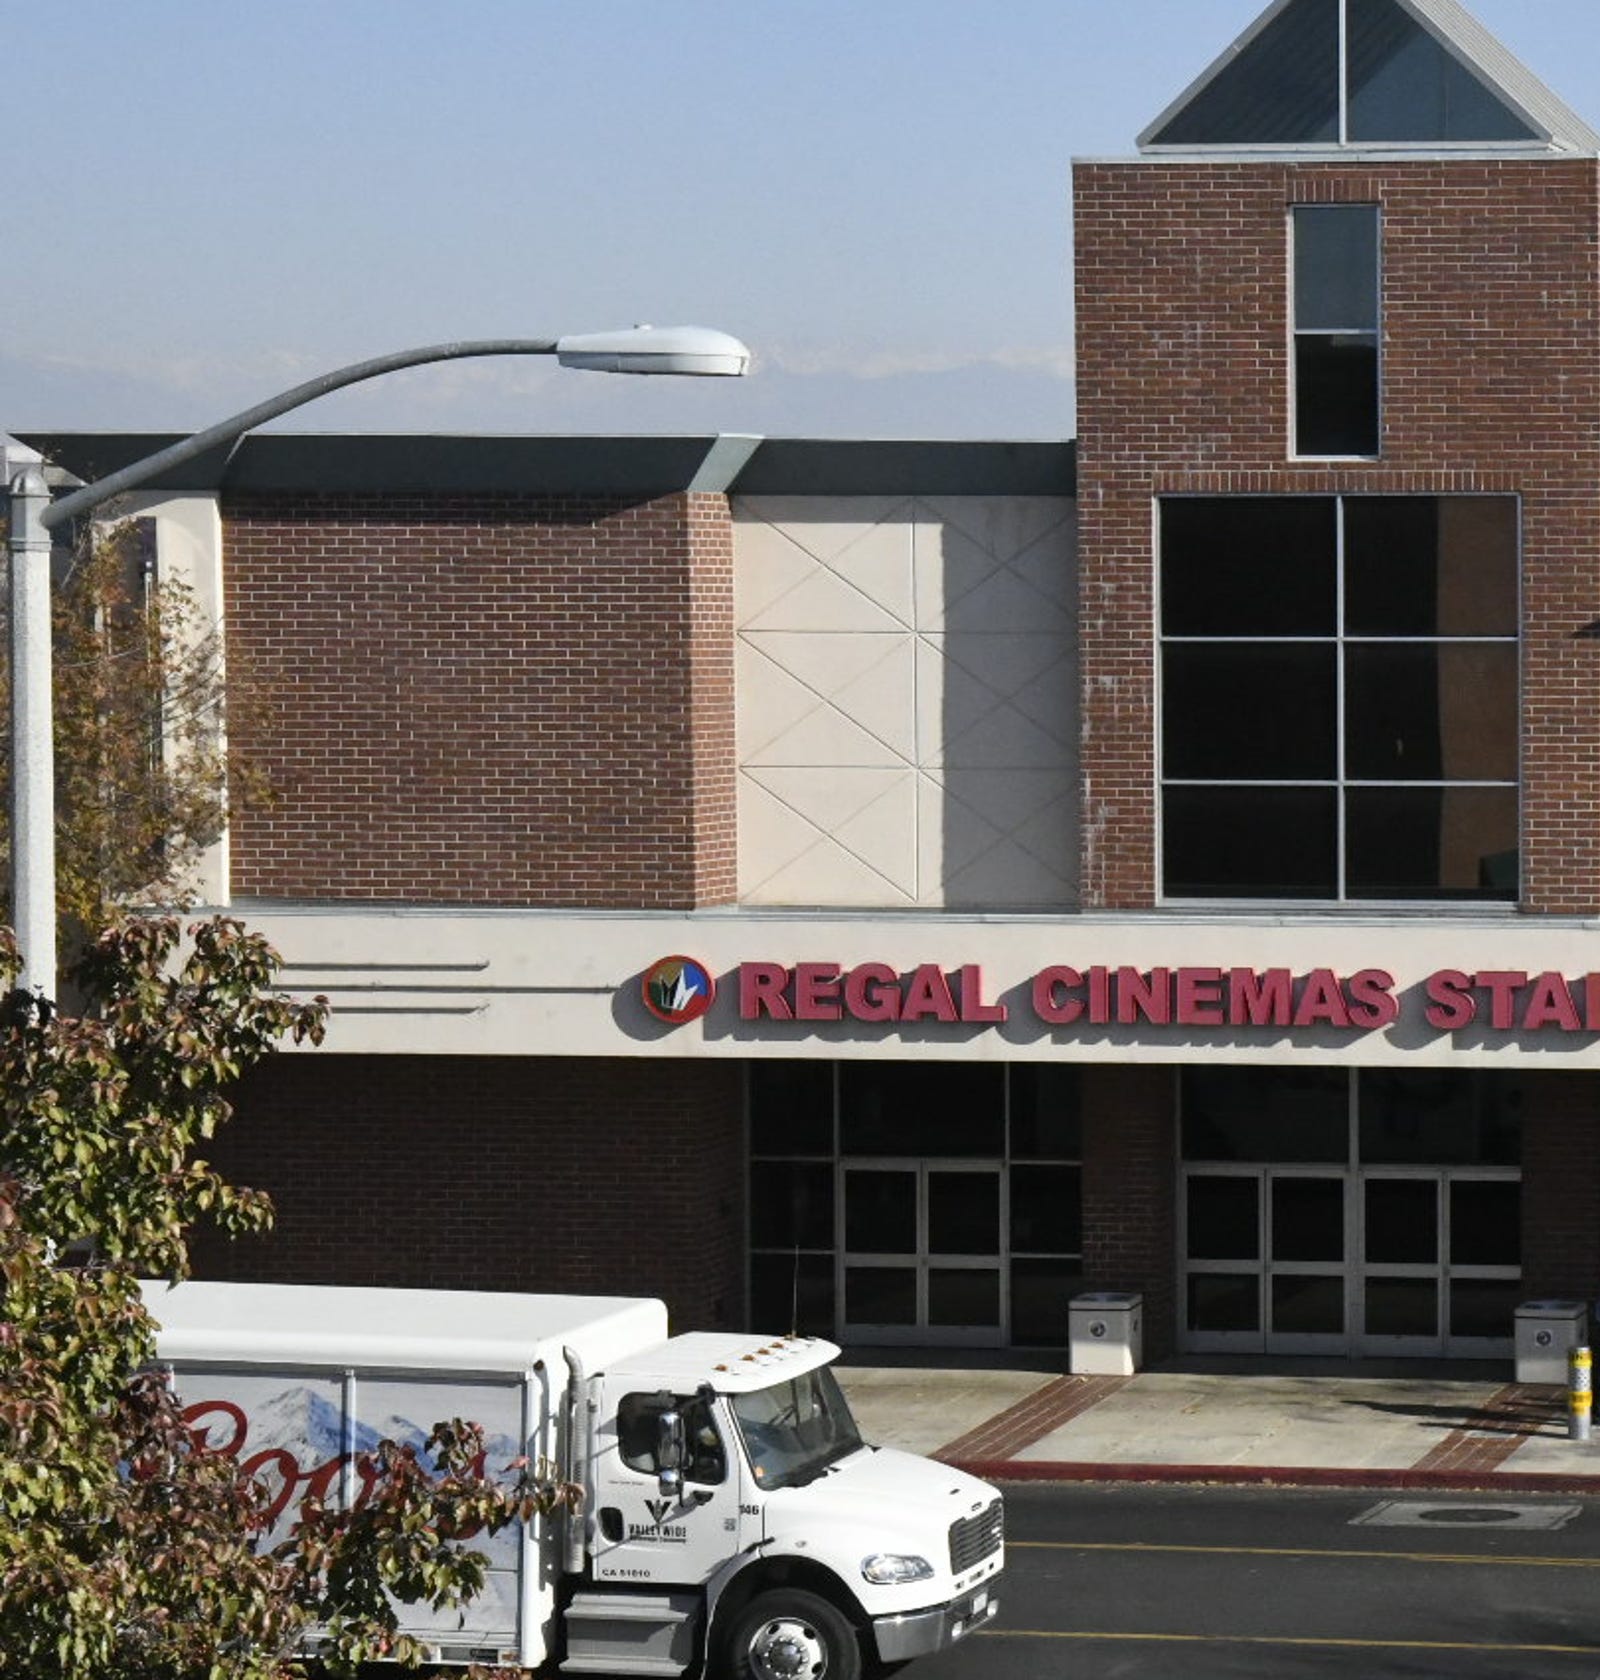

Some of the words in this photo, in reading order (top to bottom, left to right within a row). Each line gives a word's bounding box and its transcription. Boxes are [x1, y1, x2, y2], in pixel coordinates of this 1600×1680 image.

[738, 961, 1007, 1021] REGAL
[1031, 964, 1399, 1028] CINEMAS
[601, 1568, 617, 1577] CA
